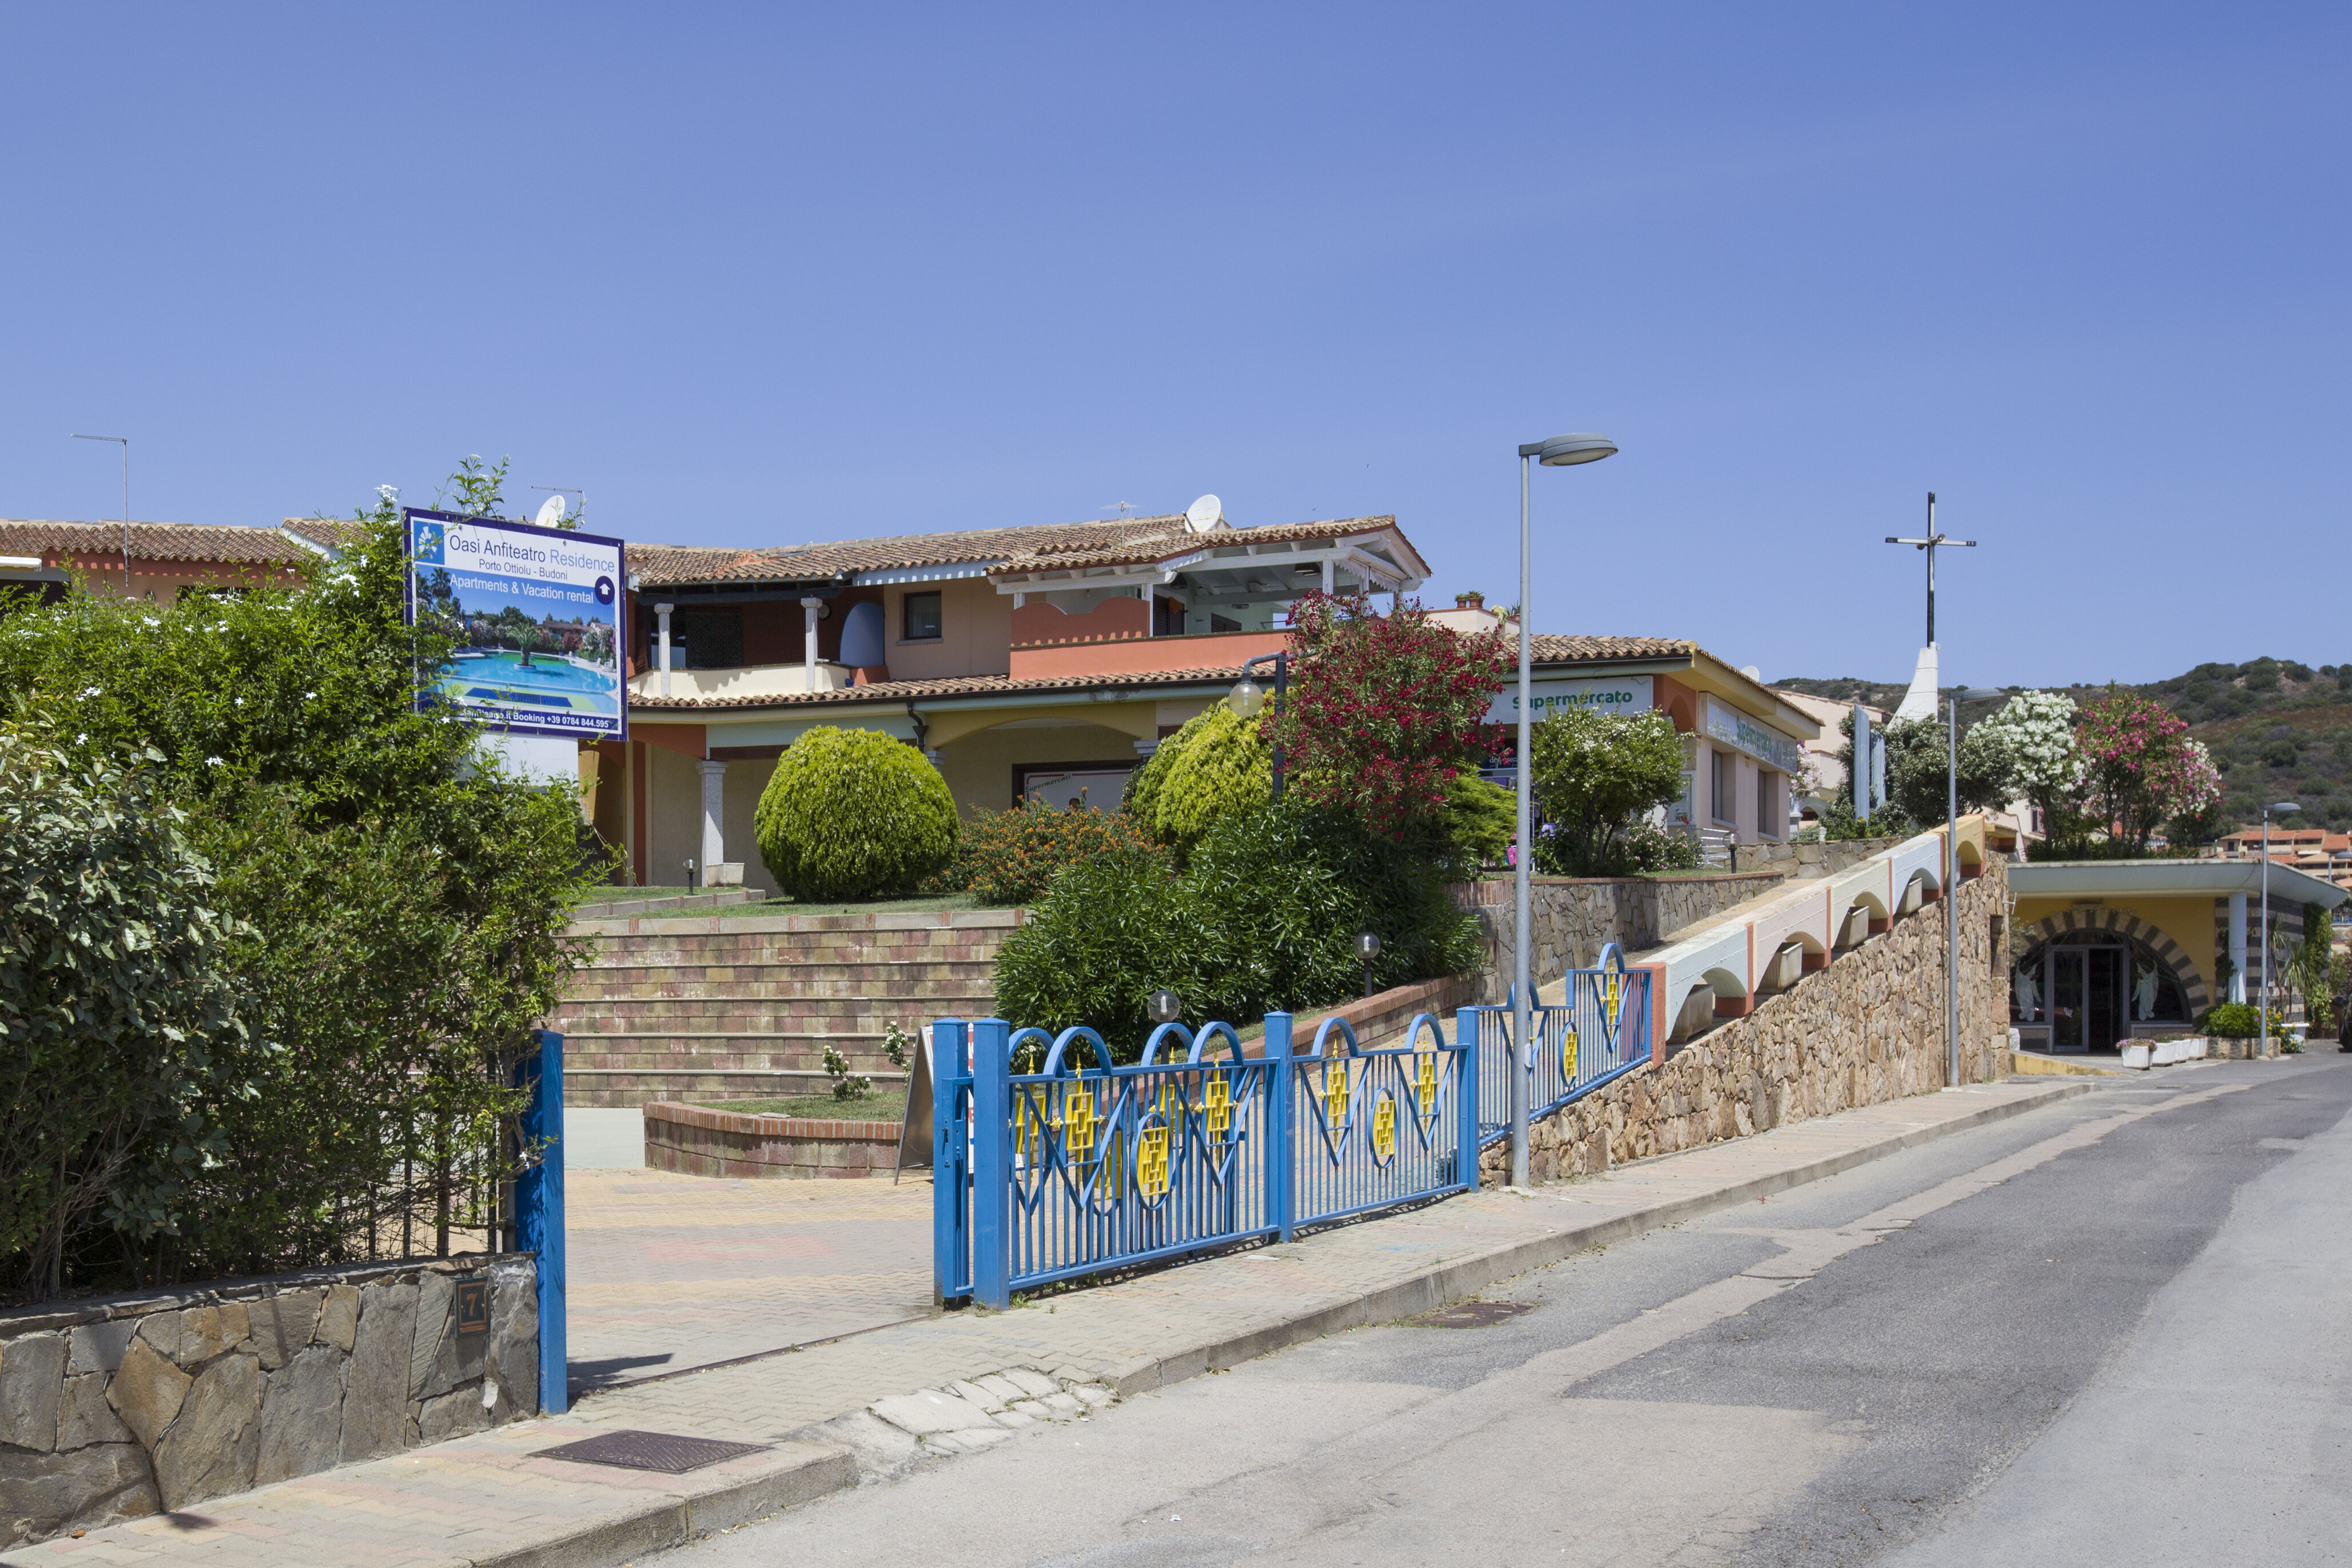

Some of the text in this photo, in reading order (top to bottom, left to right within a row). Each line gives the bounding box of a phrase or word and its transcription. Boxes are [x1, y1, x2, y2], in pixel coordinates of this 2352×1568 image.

[450, 535, 615, 572] Oasi Anfiteatro Residence
[479, 559, 502, 571] Porto
[504, 562, 531, 575] Ottiolu
[539, 567, 568, 580] Budoni
[450, 574, 594, 604] Apartments & Vacation rental
[513, 712, 546, 724] Booking
[547, 715, 560, 725] +39
[562, 717, 579, 726] 0784
[581, 718, 609, 729] 844.595
[1025, 774, 1071, 793] Supermercati
[466, 1293, 477, 1316] 7
